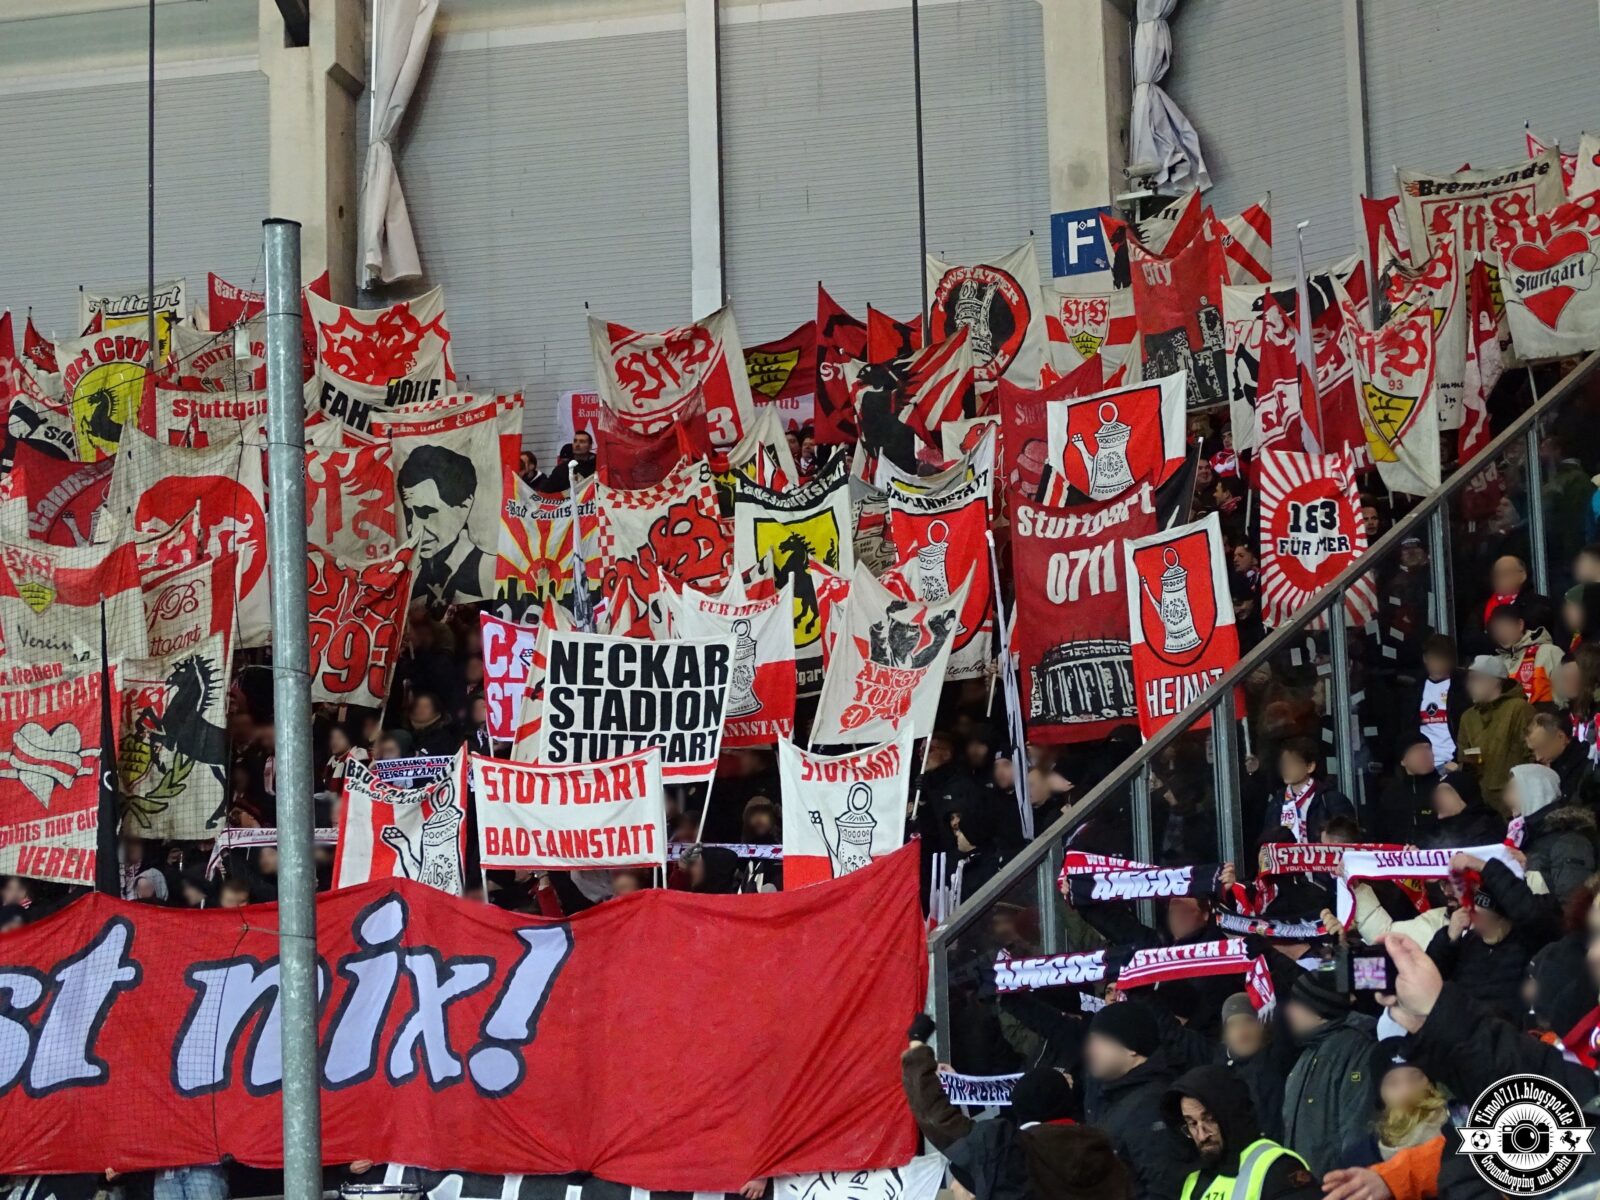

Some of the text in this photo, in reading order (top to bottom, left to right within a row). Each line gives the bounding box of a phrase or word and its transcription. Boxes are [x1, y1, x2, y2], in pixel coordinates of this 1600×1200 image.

[1514, 256, 1585, 294] Stuttgart
[94, 335, 149, 364] City
[1388, 379, 1404, 391] 93
[1017, 481, 1156, 539] Stuttgart
[1046, 540, 1118, 605] 0711
[550, 640, 730, 689] NECKAR
[550, 687, 727, 733] STADION
[550, 729, 718, 763] STUTTGART
[480, 760, 649, 806] STUTTGART
[171, 891, 575, 1098] nix!
